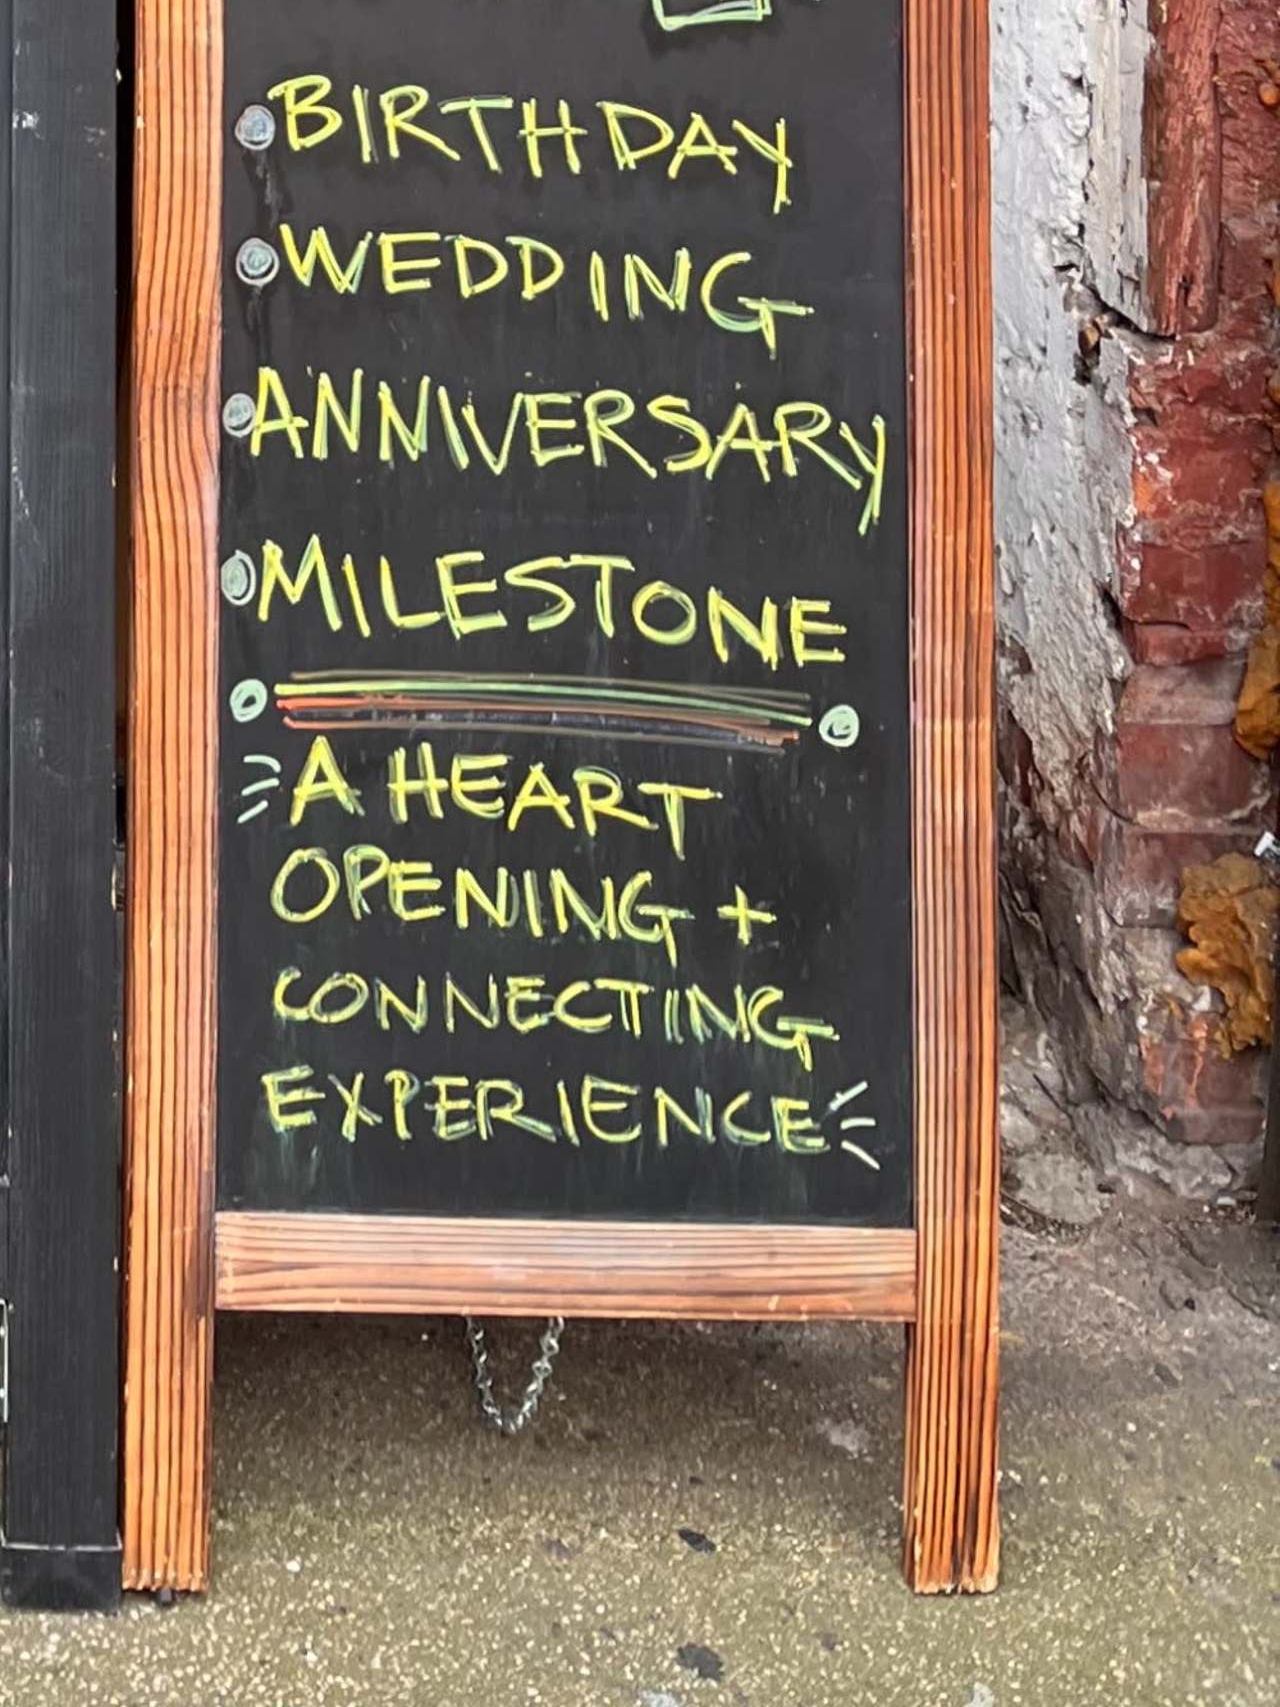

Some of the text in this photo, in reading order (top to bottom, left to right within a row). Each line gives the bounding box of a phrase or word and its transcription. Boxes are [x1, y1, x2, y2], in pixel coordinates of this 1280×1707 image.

[267, 74, 793, 214] BIRTHDAY
[279, 222, 814, 360] WEDDING
[251, 365, 887, 536] ANNIVERSARY
[258, 534, 847, 671] MILESTONE
[290, 735, 723, 861] A HEART
[270, 845, 695, 969] OPENING
[273, 967, 840, 1071] CONNECTING
[261, 1064, 831, 1155] EXPERIENCE
